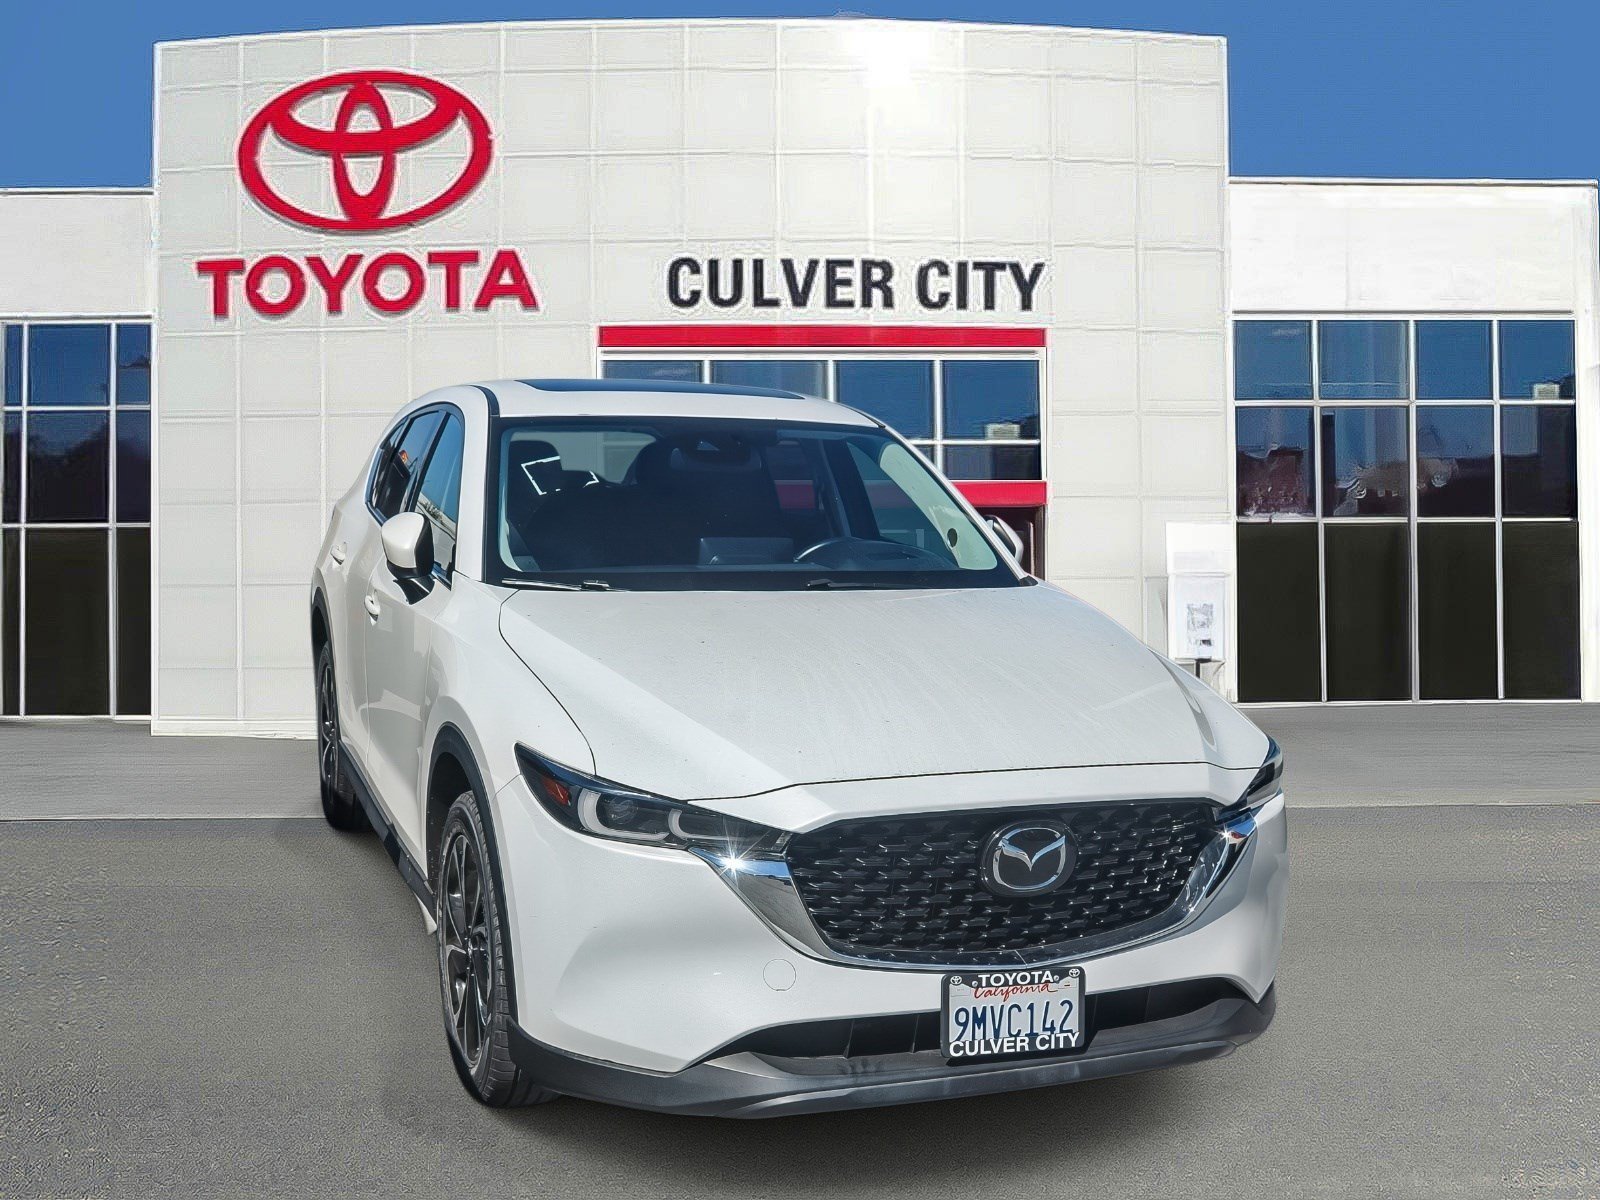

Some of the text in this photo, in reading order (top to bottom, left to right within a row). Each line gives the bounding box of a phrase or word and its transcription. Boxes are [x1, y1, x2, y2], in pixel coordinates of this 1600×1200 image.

[196, 250, 539, 319] TOYOTA
[667, 257, 1045, 311] CULVER CITY
[973, 983, 1058, 1002] California
[978, 970, 1054, 987] TOYOTA
[955, 1000, 1073, 1041] 9MVC142
[949, 1031, 1080, 1057] CULVER CITY
